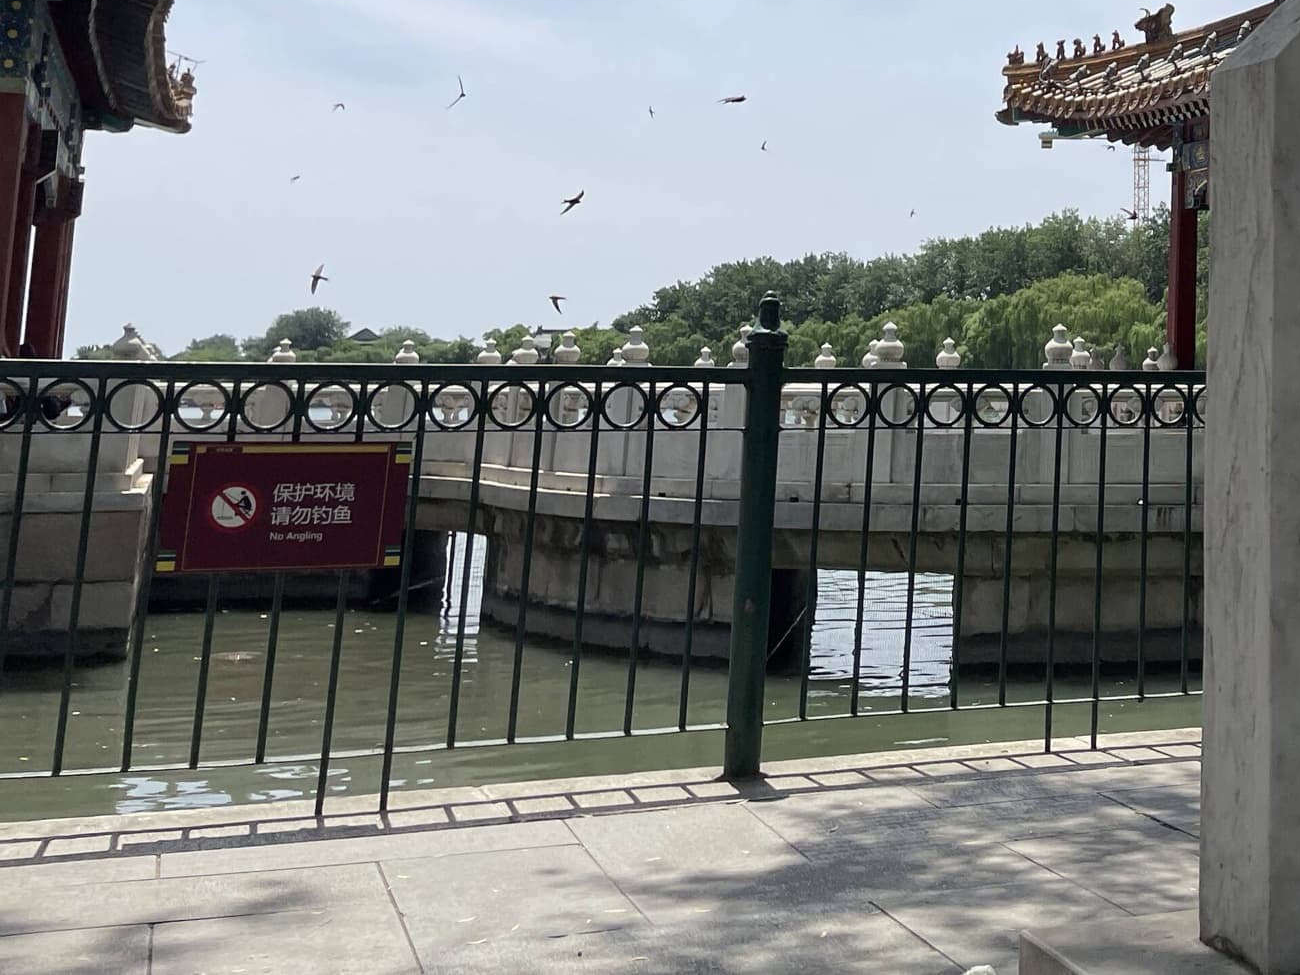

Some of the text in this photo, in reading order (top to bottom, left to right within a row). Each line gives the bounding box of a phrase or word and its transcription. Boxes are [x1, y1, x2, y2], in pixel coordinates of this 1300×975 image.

[272, 482, 355, 502] 保护环境
[270, 505, 353, 526] 请勿钓鱼
[270, 531, 323, 542] No Angling
